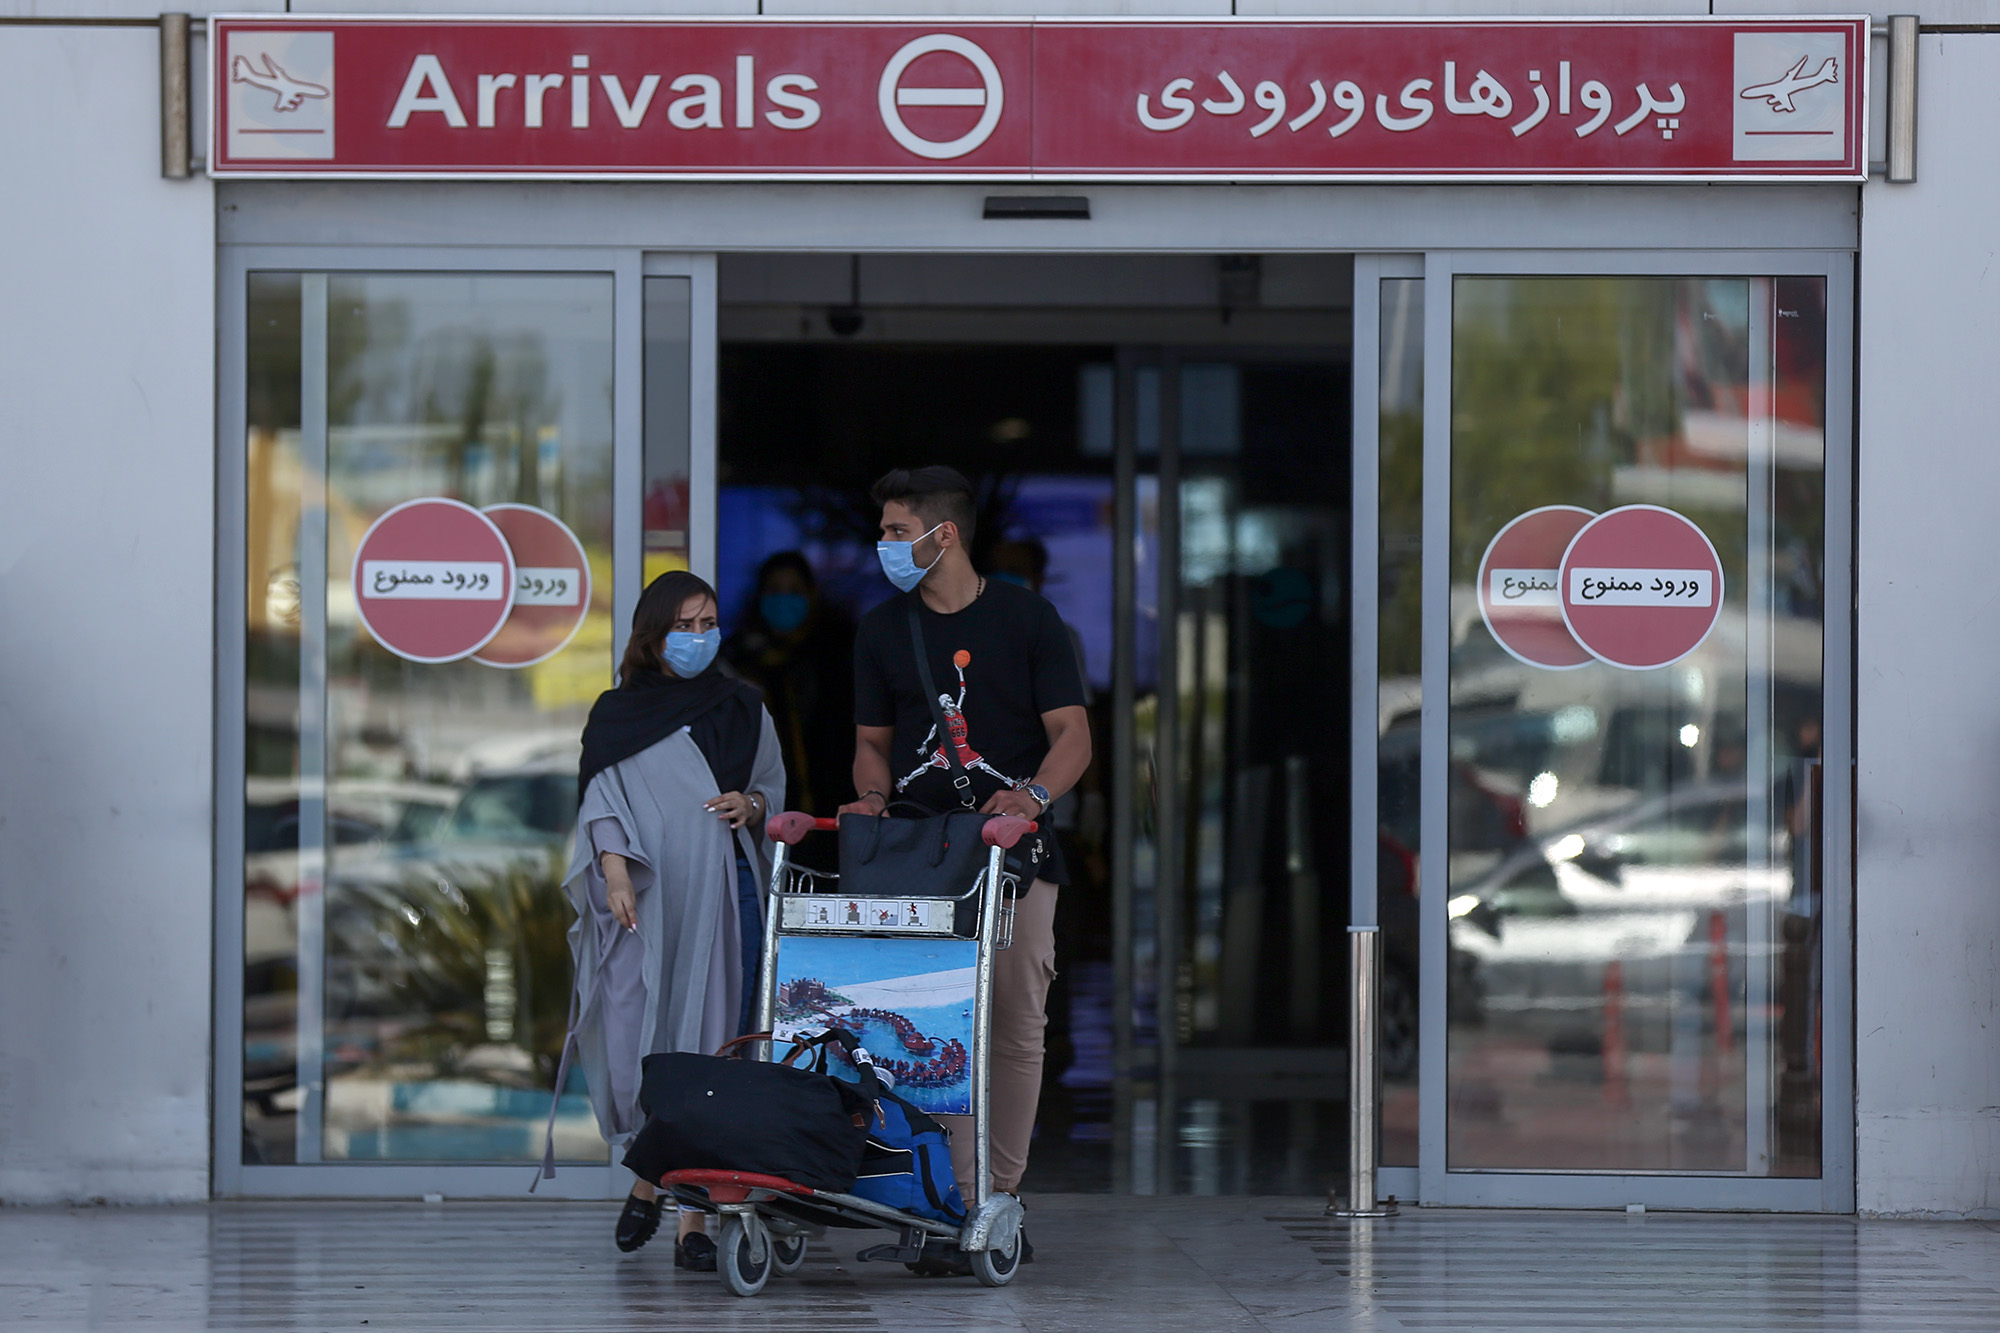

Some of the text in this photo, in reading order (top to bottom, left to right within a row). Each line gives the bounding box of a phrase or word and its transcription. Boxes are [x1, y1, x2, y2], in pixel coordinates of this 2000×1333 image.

[386, 54, 822, 130] Arrivals
[1136, 60, 1686, 140] پروازهای ورودی
[374, 569, 489, 593] ورود ممنوع
[519, 576, 567, 596] ورود
[1502, 576, 1558, 600] منوع
[1581, 576, 1699, 600] ورود ممنوع
